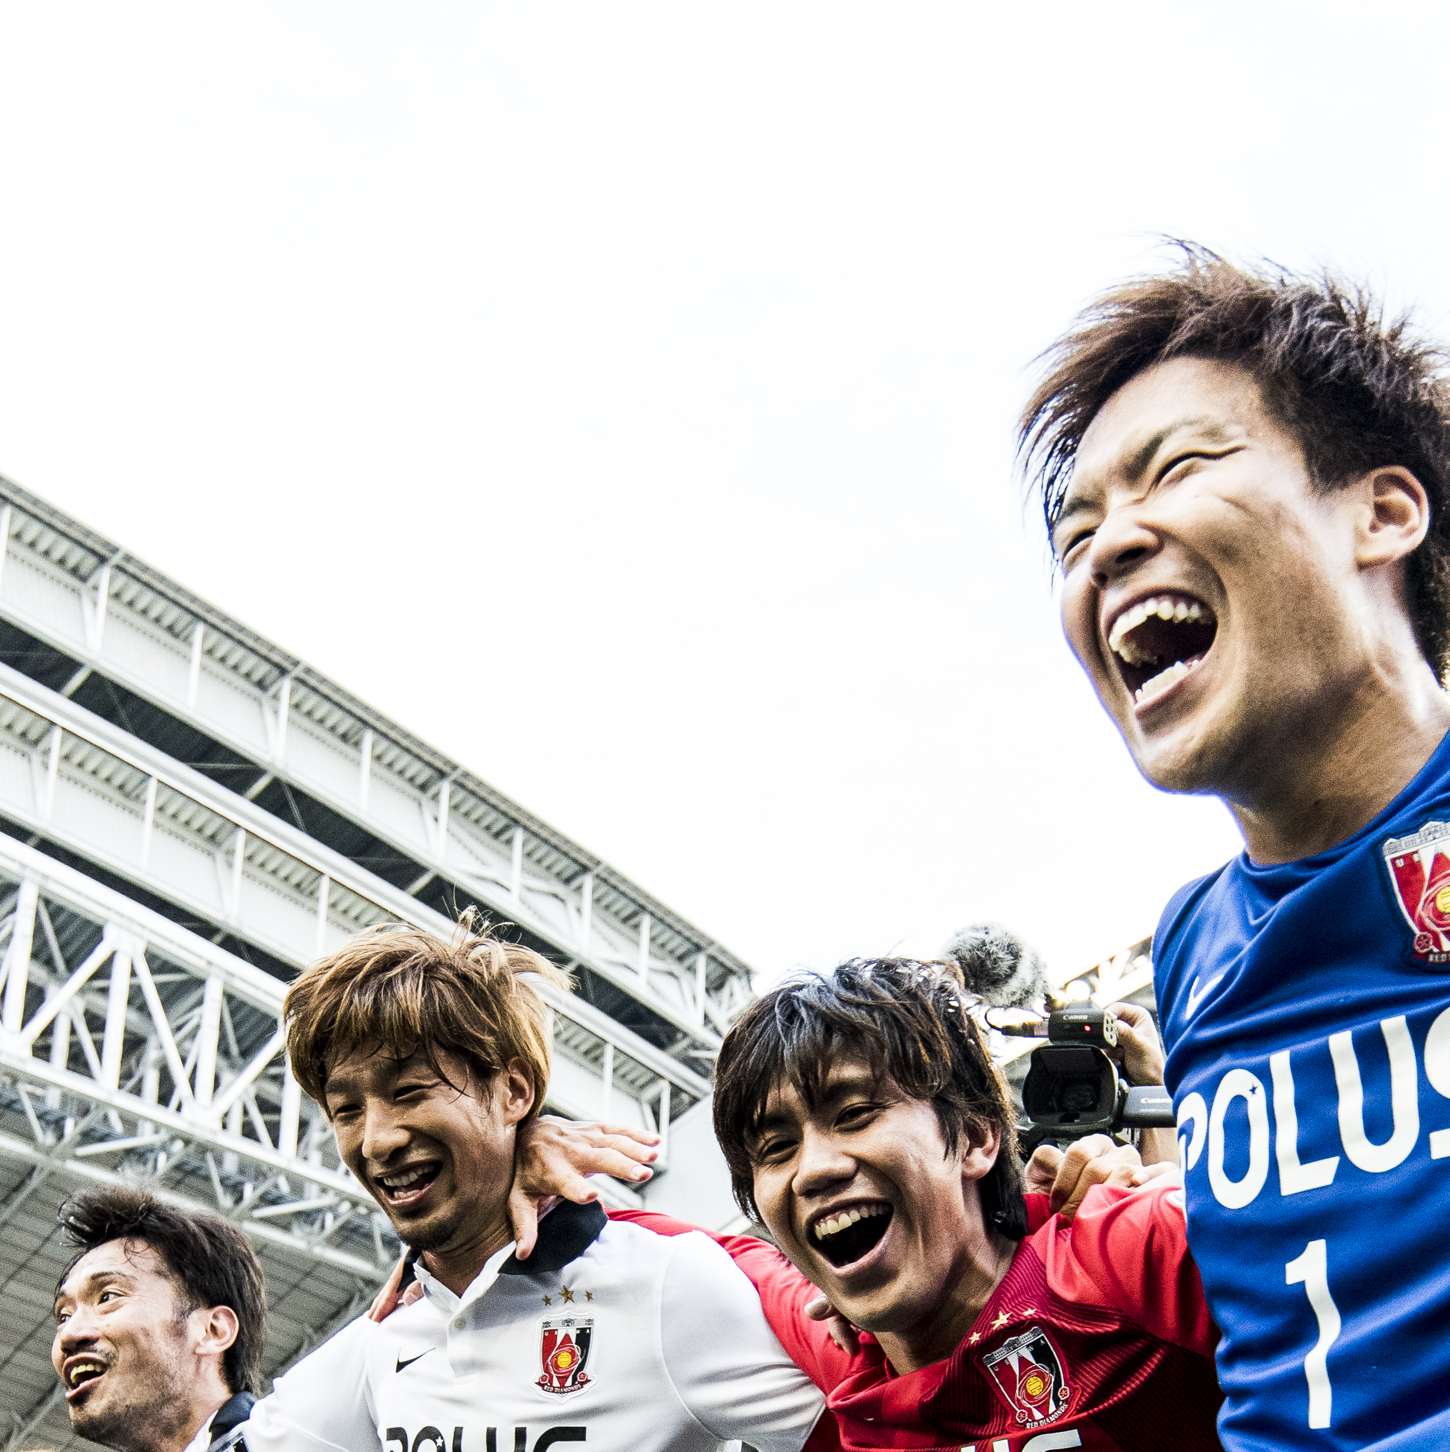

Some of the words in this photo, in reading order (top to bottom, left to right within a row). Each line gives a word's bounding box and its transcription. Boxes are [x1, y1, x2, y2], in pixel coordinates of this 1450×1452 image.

[1285, 1238, 1342, 1430] 1
[1026, 1420, 1039, 1430] RED
[1039, 1402, 1068, 1427] DIAMONDS
